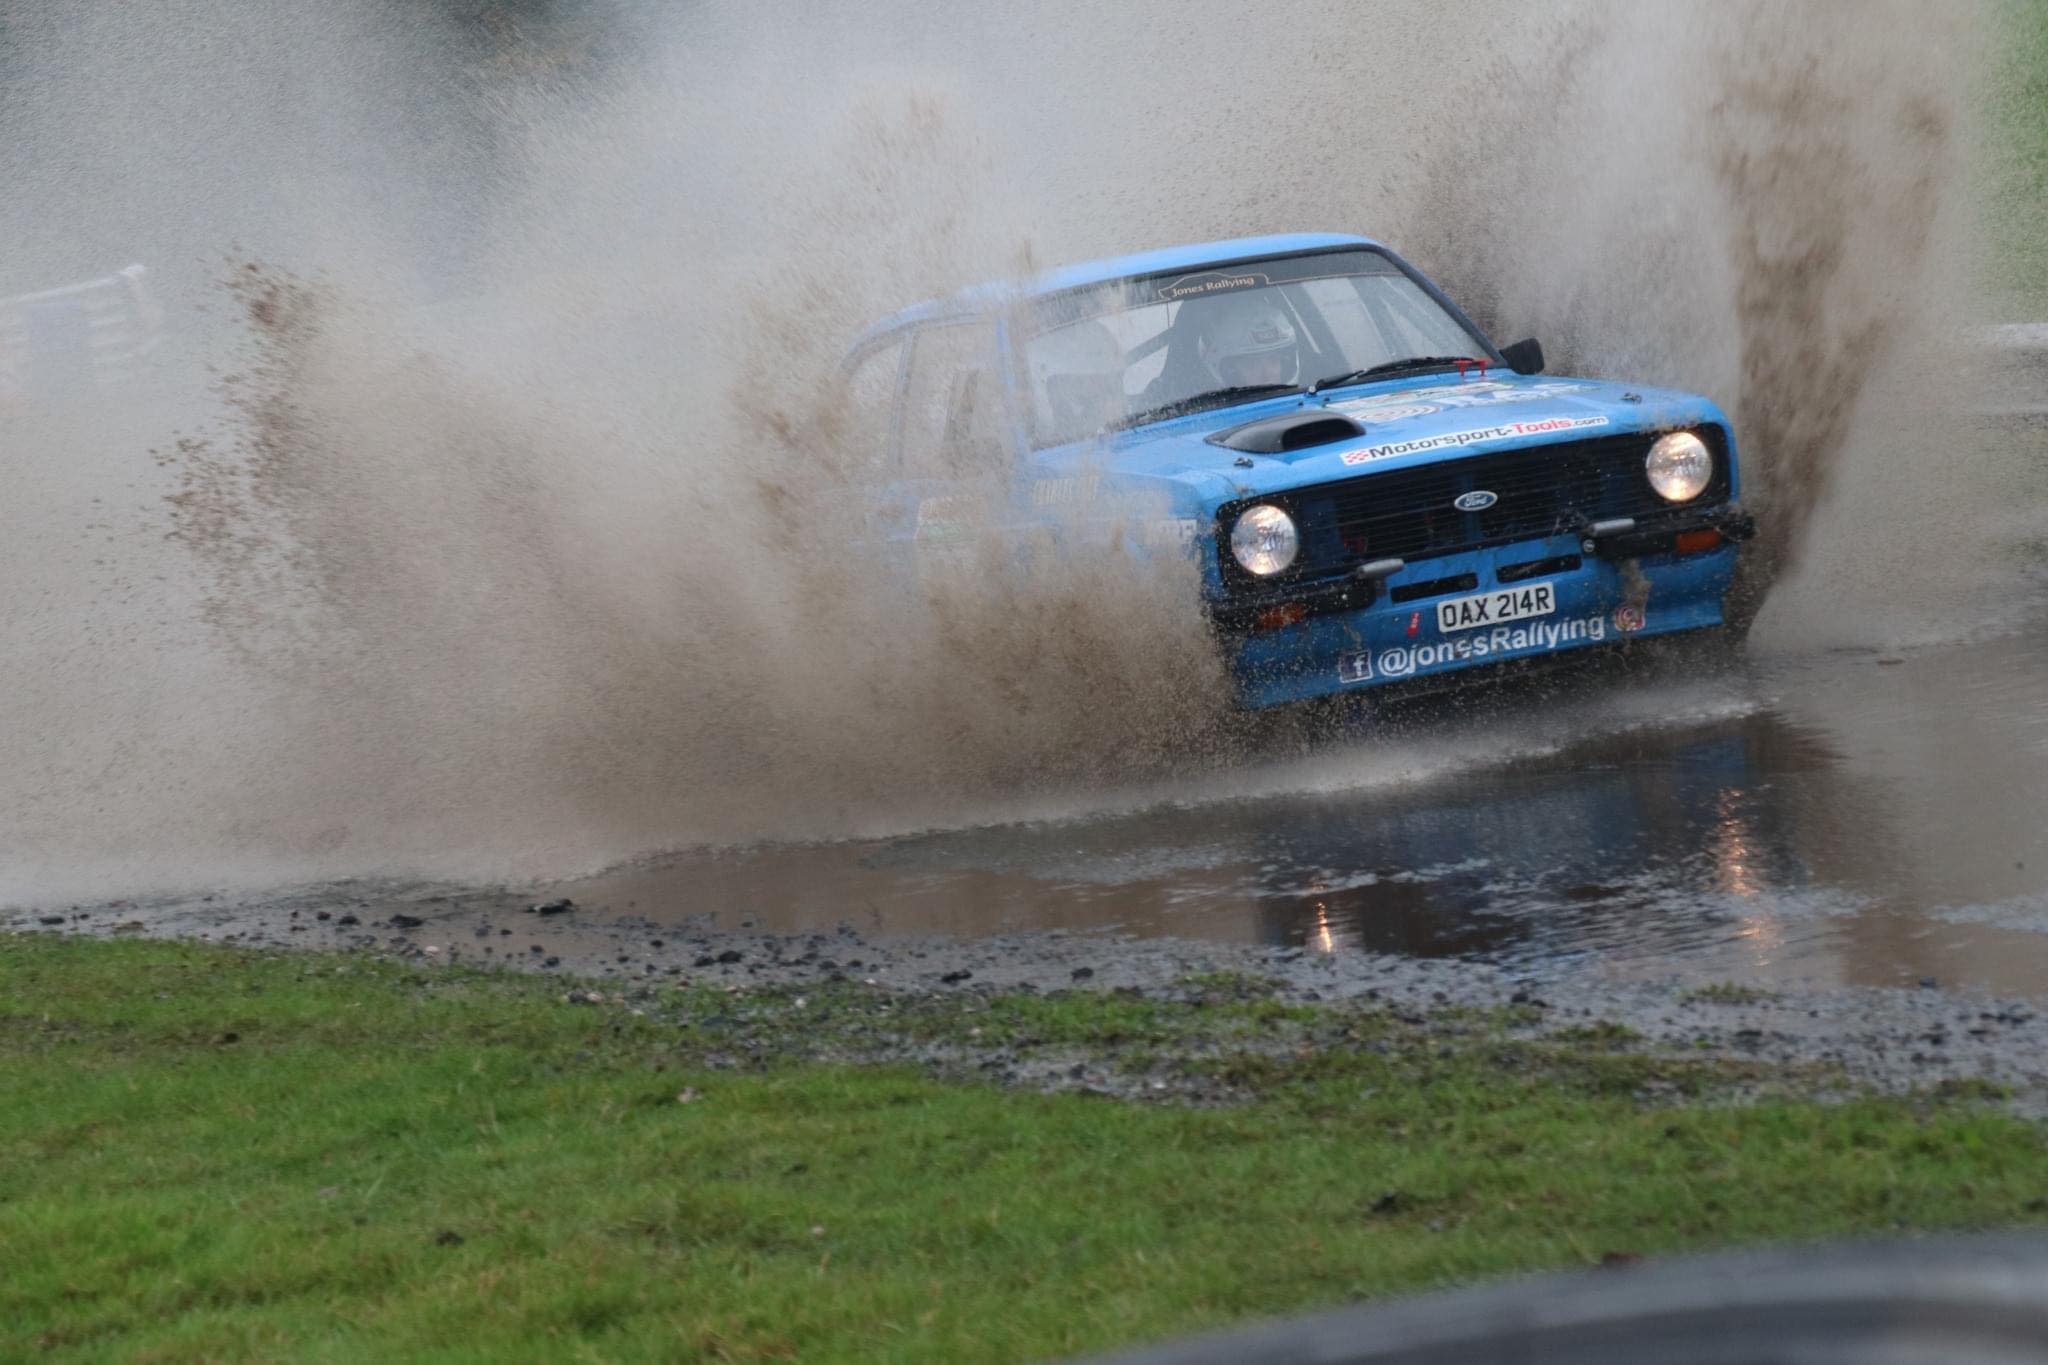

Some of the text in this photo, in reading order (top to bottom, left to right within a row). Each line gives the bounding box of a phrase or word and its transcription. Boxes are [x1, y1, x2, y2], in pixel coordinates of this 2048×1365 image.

[1172, 277, 1255, 297] Jones Rallying
[1441, 600, 1490, 628] OAX
[1496, 587, 1551, 618] 214R
[1377, 615, 1607, 677] @jonesRallying
